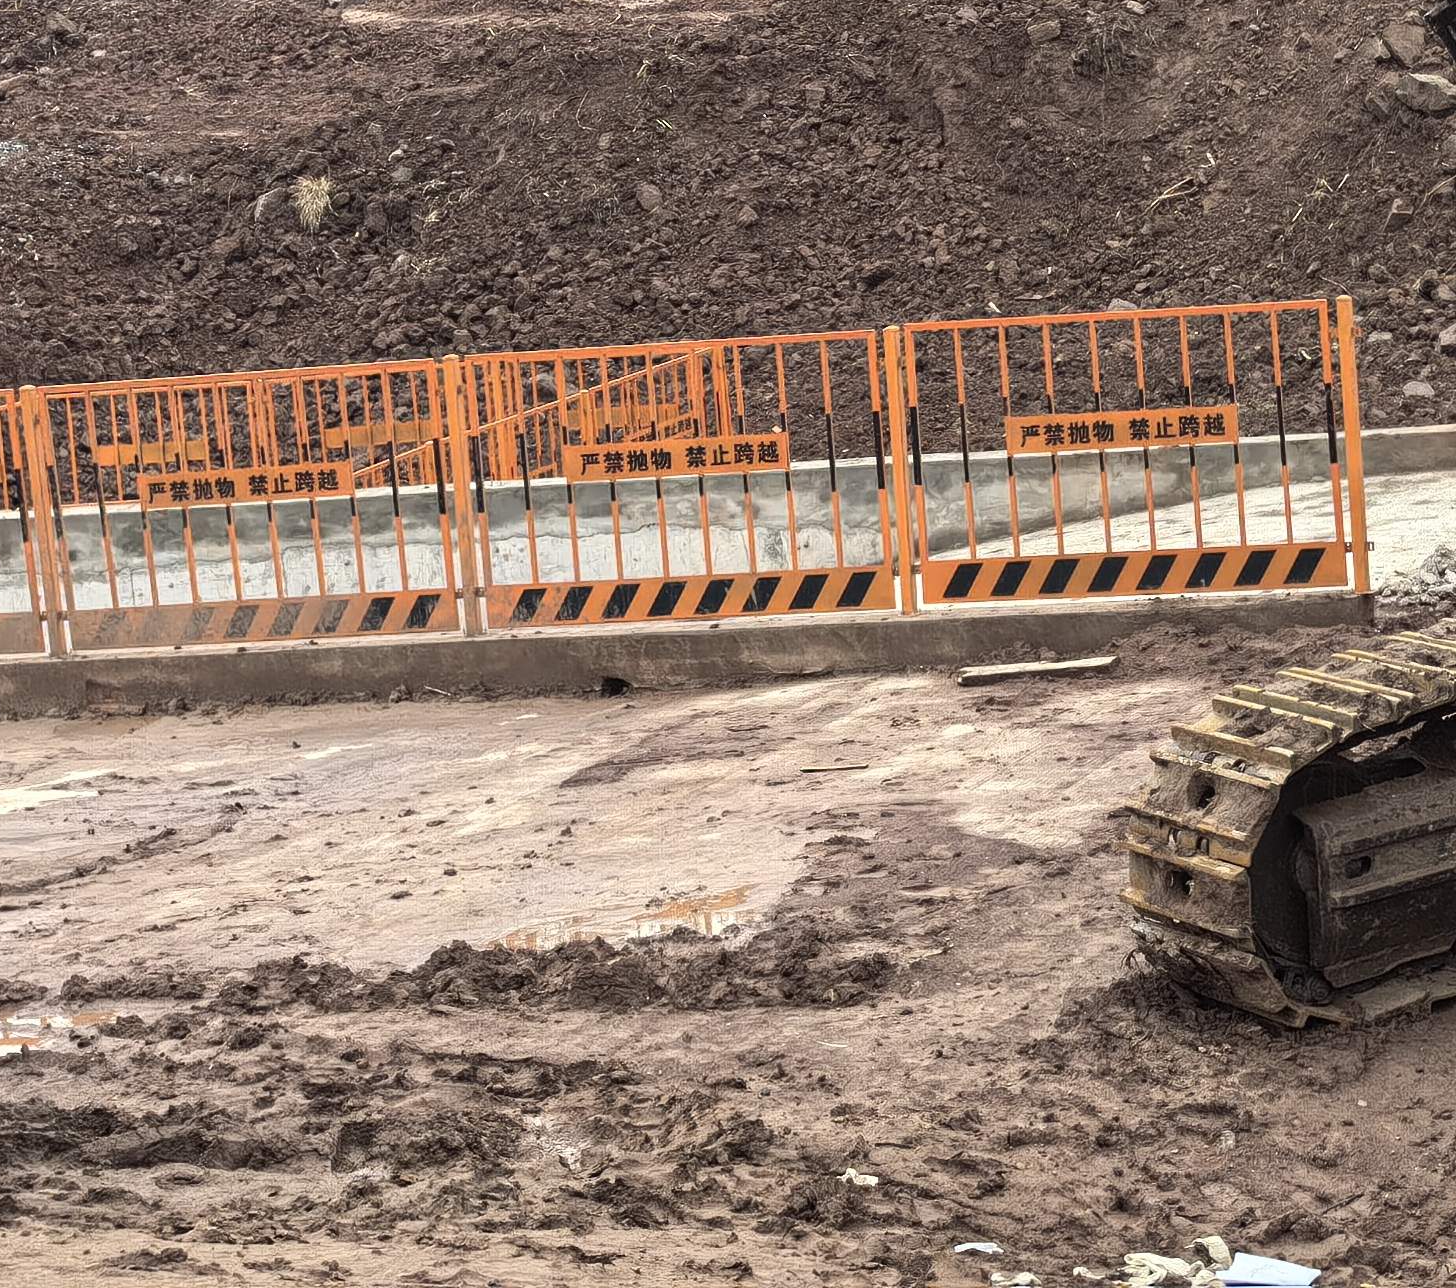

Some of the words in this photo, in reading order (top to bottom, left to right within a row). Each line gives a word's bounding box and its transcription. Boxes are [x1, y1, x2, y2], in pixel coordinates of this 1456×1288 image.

[1020, 420, 1114, 447] 严禁抛物
[1129, 413, 1226, 440] 禁止跨越
[580, 448, 672, 475] 严禁抛物
[685, 441, 780, 467] 禁止跨越
[148, 477, 236, 503] 严禁抛物
[248, 469, 339, 495] 禁止跨越
